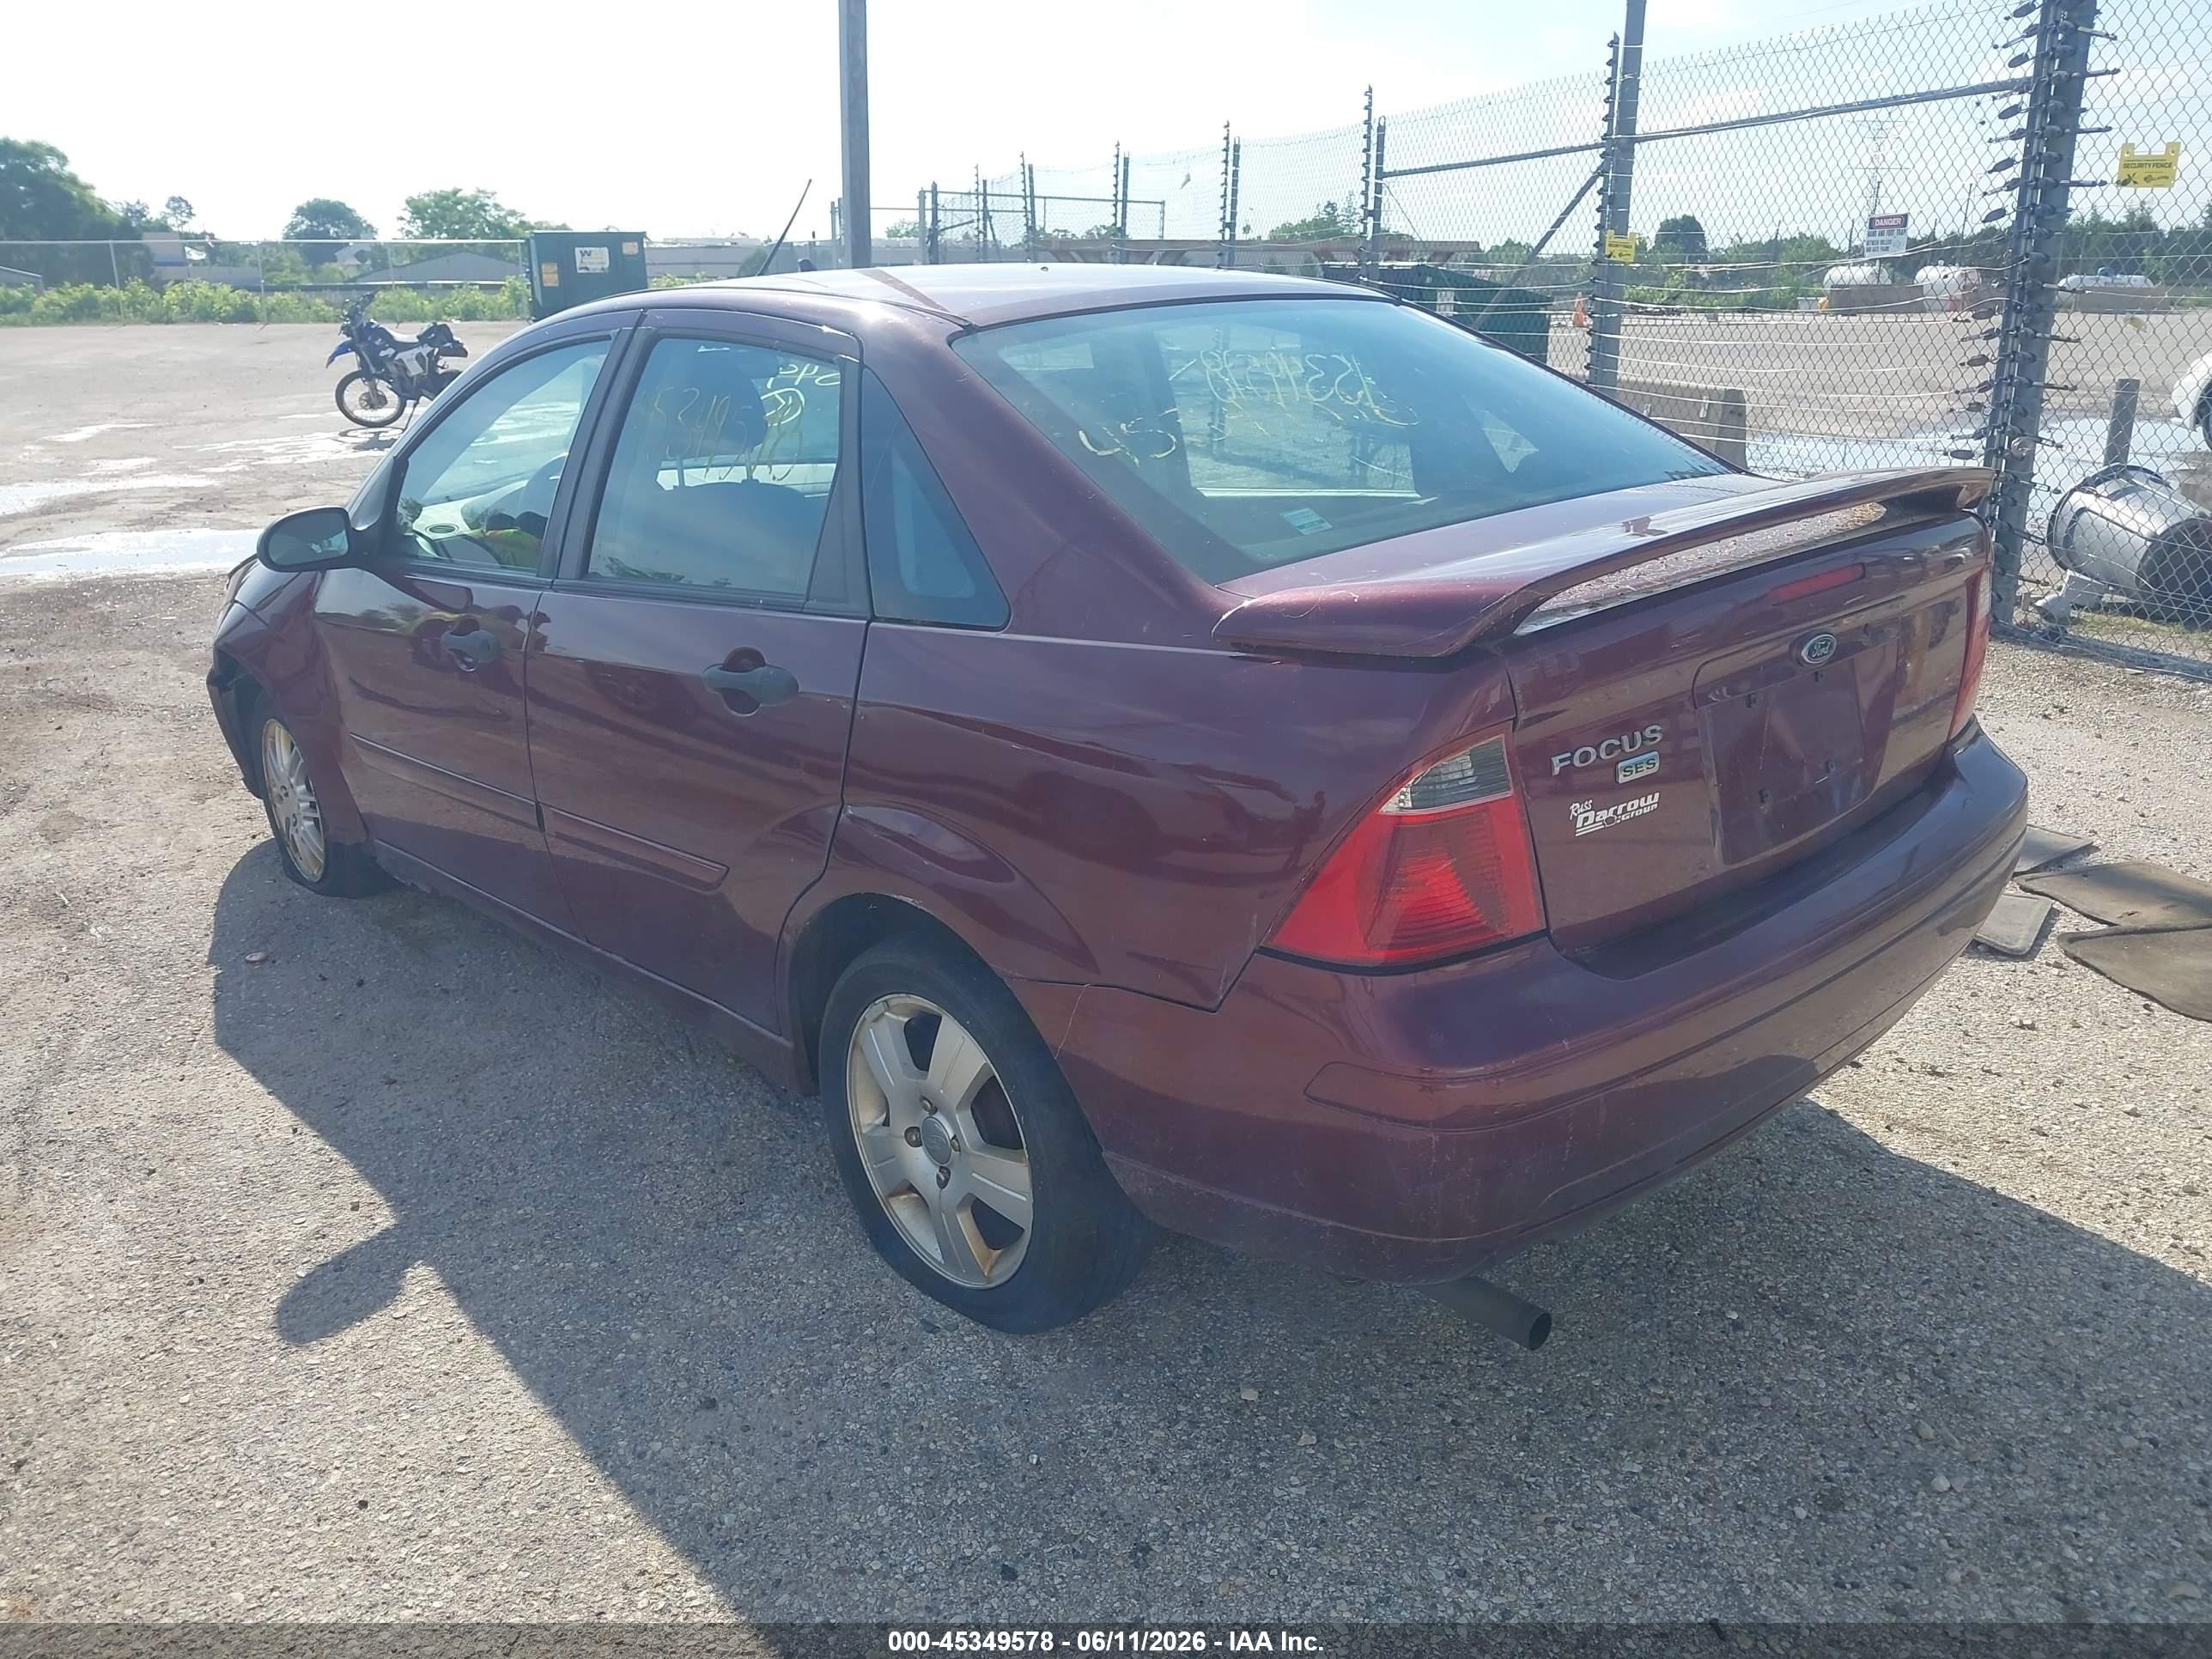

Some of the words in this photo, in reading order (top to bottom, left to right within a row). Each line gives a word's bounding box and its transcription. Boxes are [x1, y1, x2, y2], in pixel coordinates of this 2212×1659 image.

[1875, 217, 1901, 227] DANGER
[1551, 725, 1663, 776] FOCUS
[1622, 757, 1656, 778] SES
[1569, 799, 1593, 821] Russ
[1575, 792, 1660, 829] Darrow
